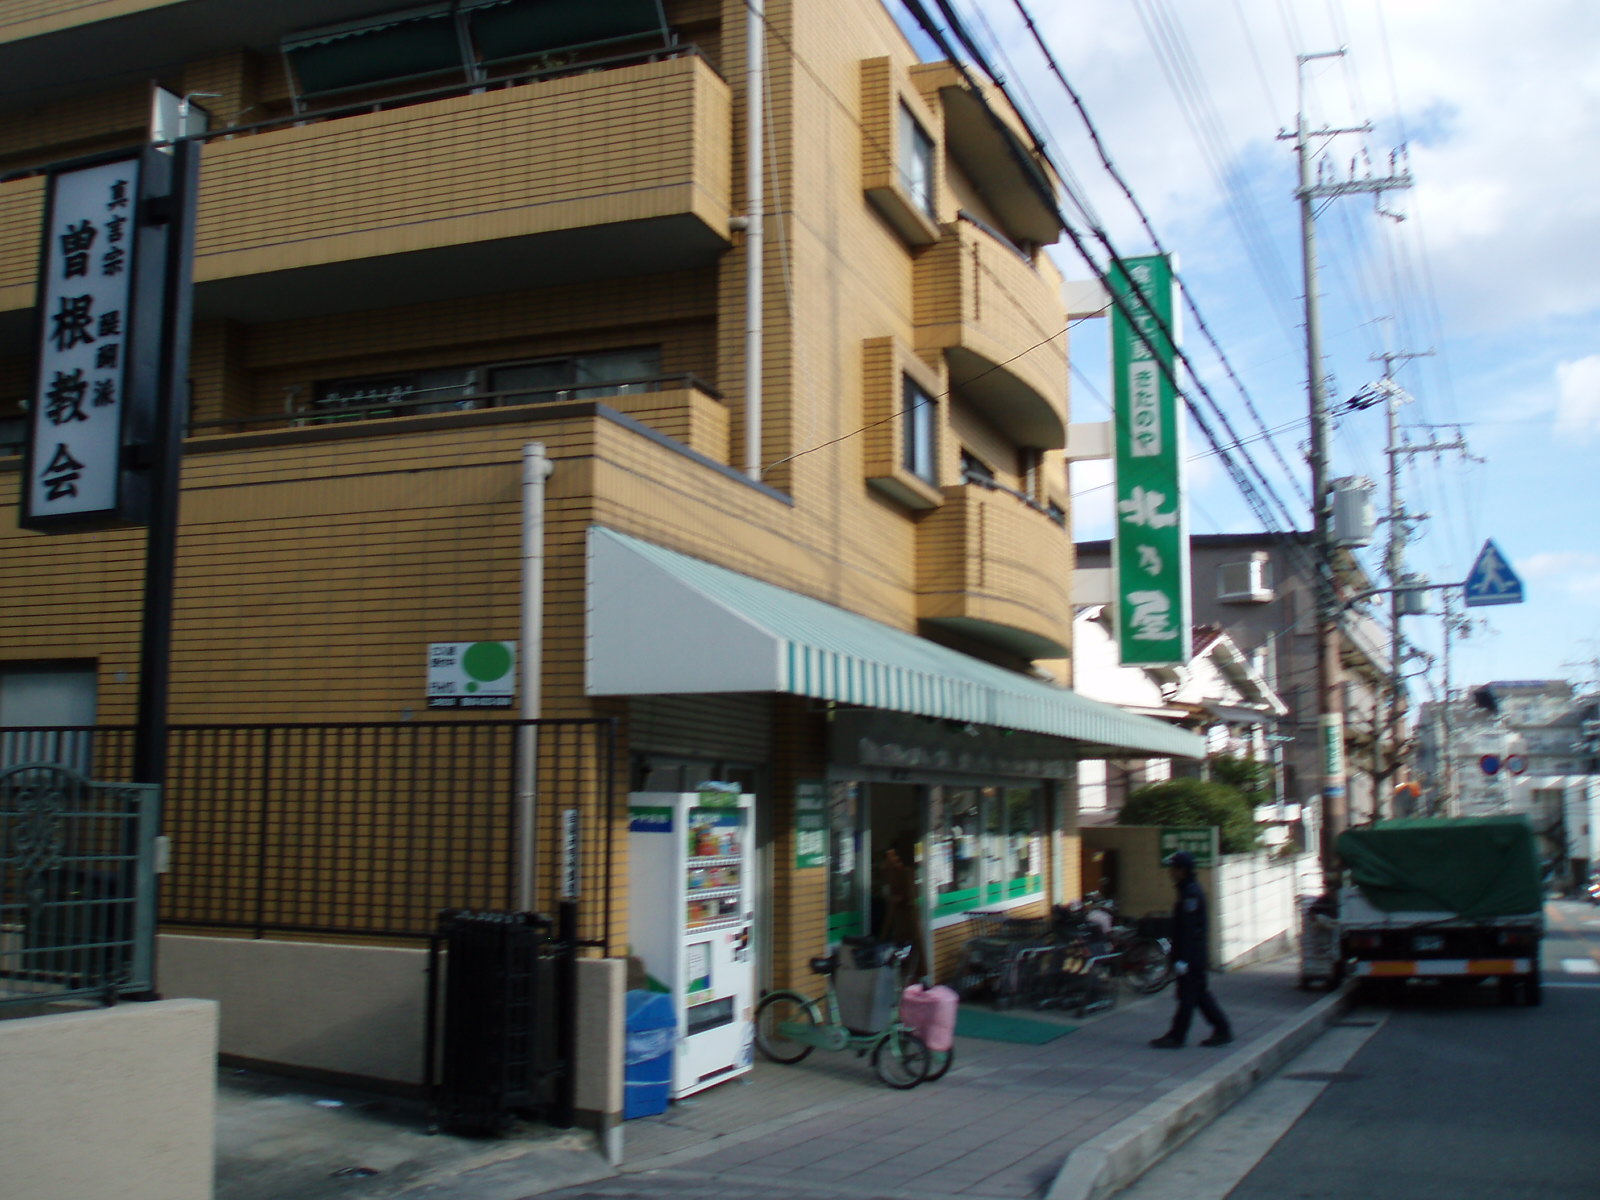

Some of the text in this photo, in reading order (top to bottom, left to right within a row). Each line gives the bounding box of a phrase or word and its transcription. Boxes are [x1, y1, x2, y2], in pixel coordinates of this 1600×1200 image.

[101, 178, 130, 278] 真言宗
[40, 218, 99, 502] 曽根教会
